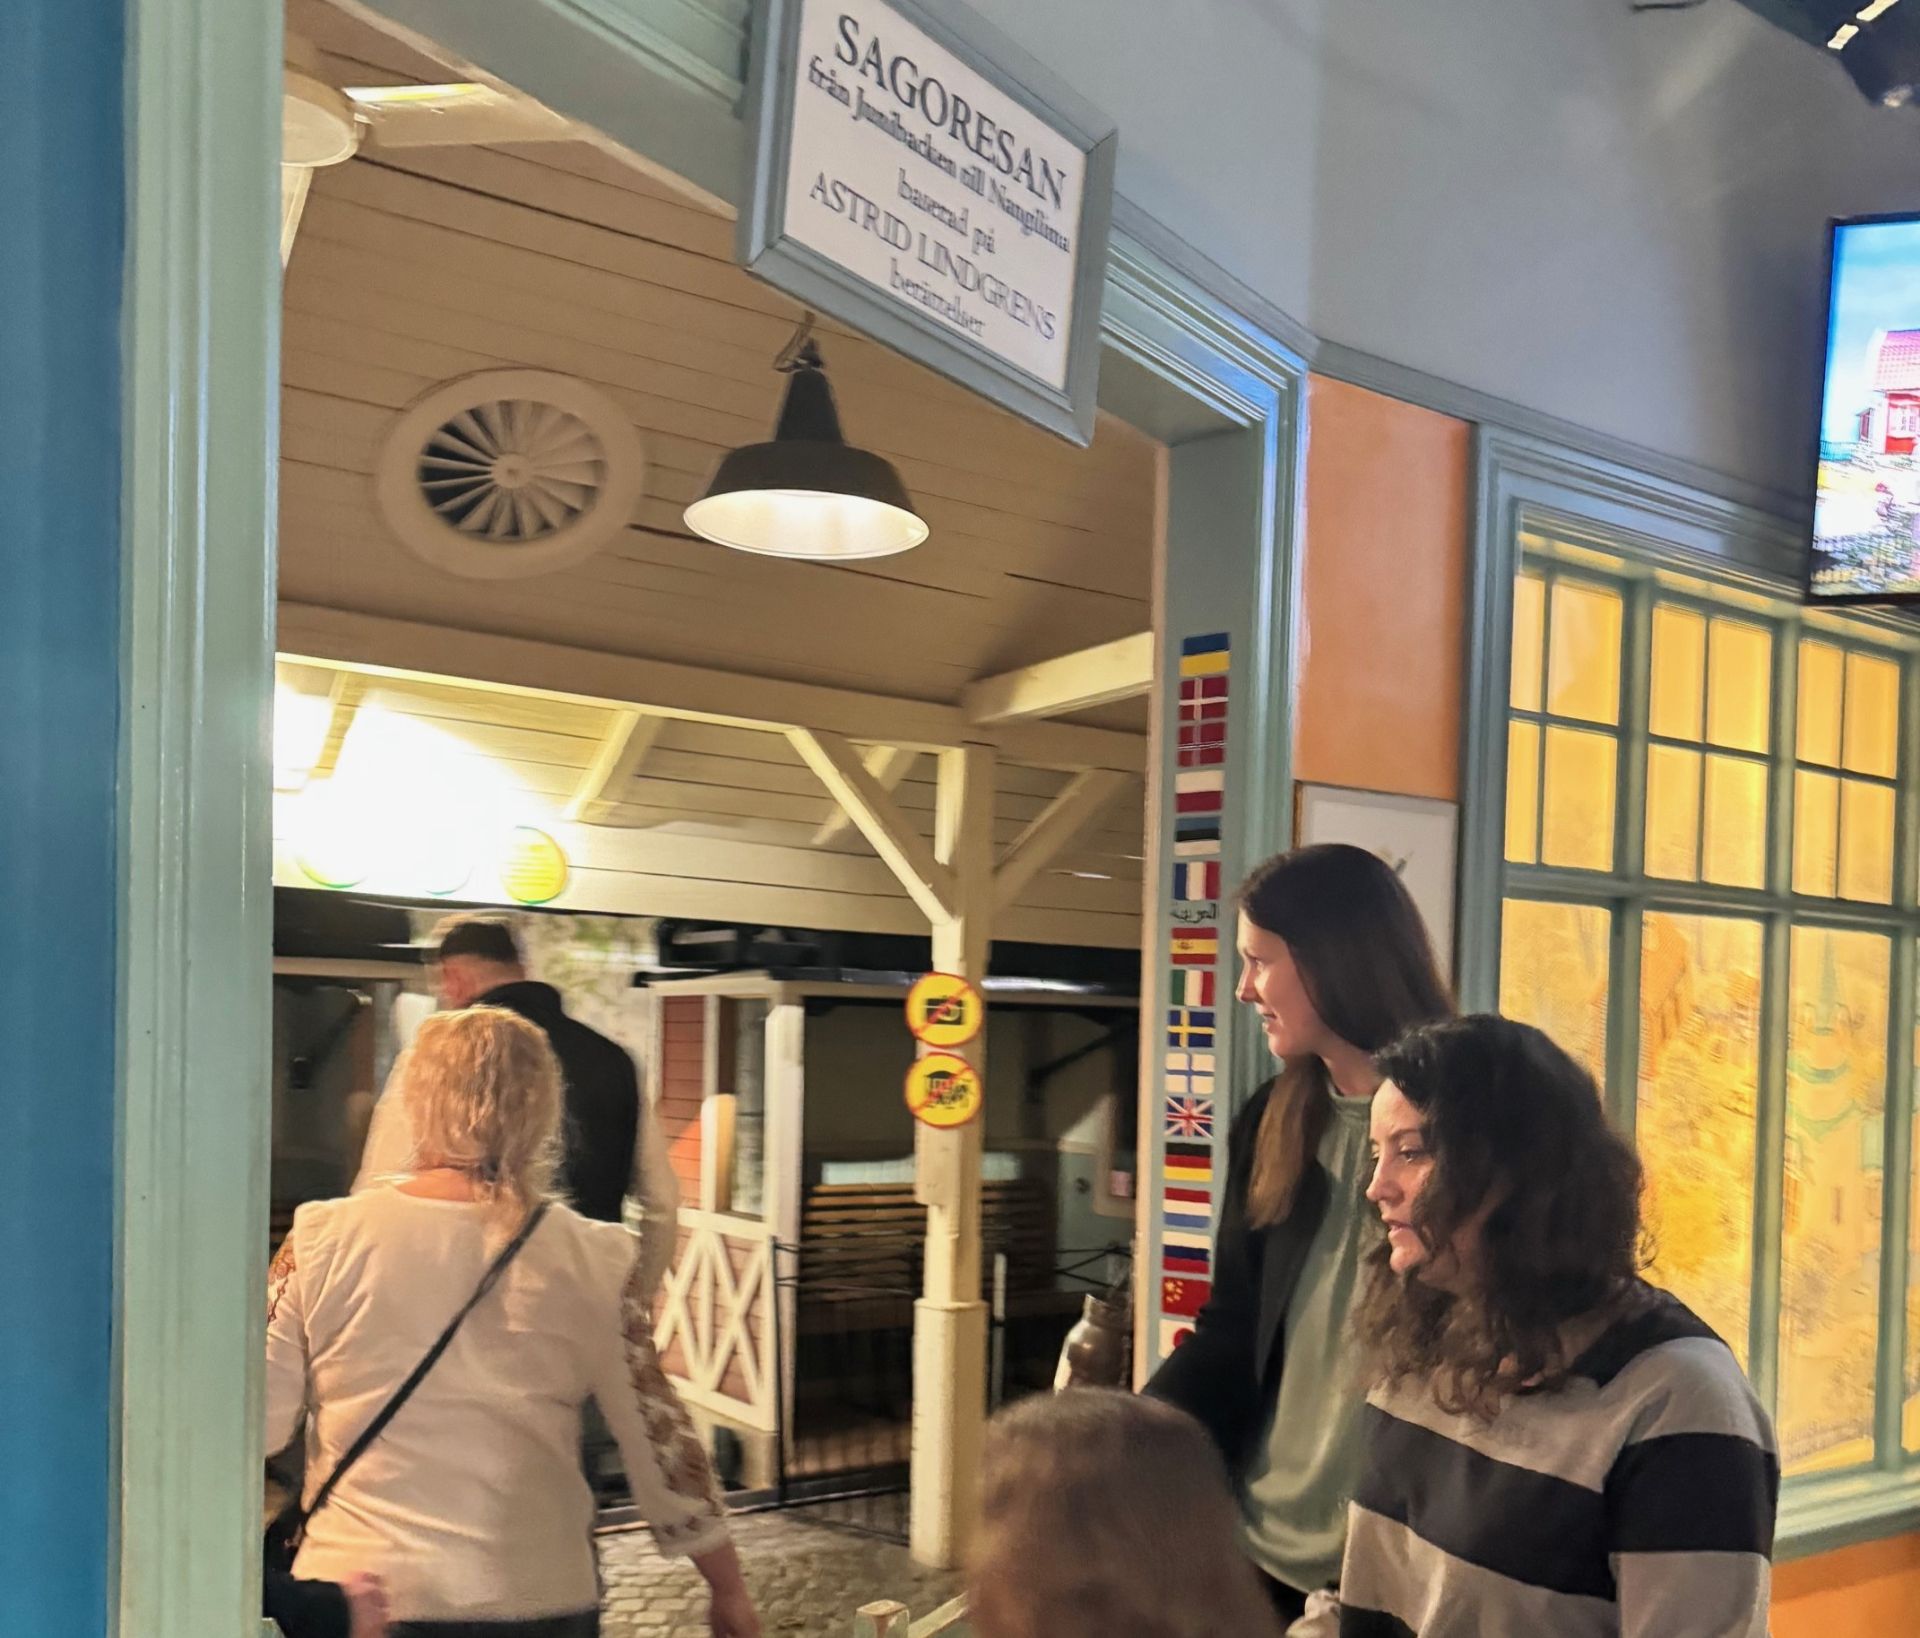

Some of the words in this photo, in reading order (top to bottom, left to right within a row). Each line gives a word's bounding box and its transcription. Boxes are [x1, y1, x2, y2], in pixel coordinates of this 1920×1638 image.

[834, 13, 1067, 210] SAGORESAN
[809, 171, 912, 252] ASTRID
[917, 231, 1057, 341] LINDGRENS
